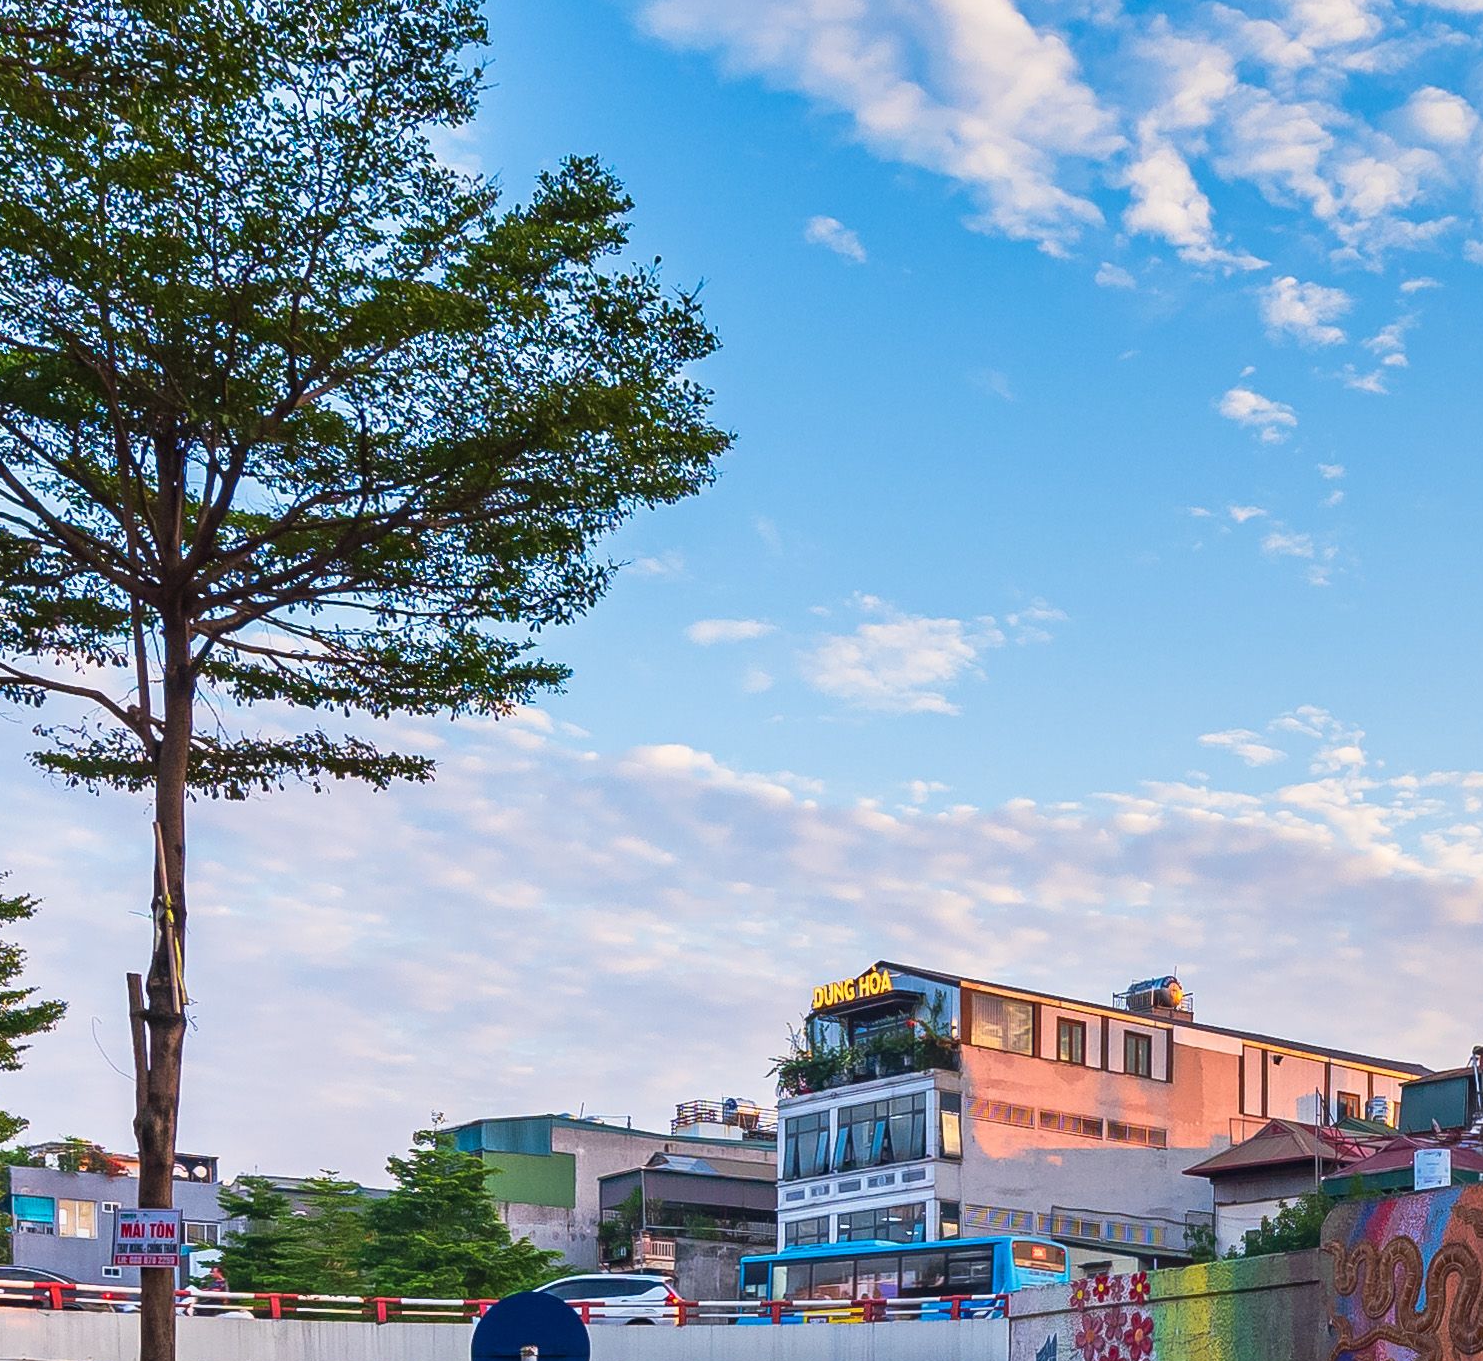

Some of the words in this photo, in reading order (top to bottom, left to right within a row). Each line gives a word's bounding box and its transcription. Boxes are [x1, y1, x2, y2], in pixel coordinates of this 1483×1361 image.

[812, 978, 856, 1009] DUNG
[858, 965, 894, 998] HÒA
[121, 1220, 146, 1238] MÁI
[149, 1220, 175, 1239] TÔN
